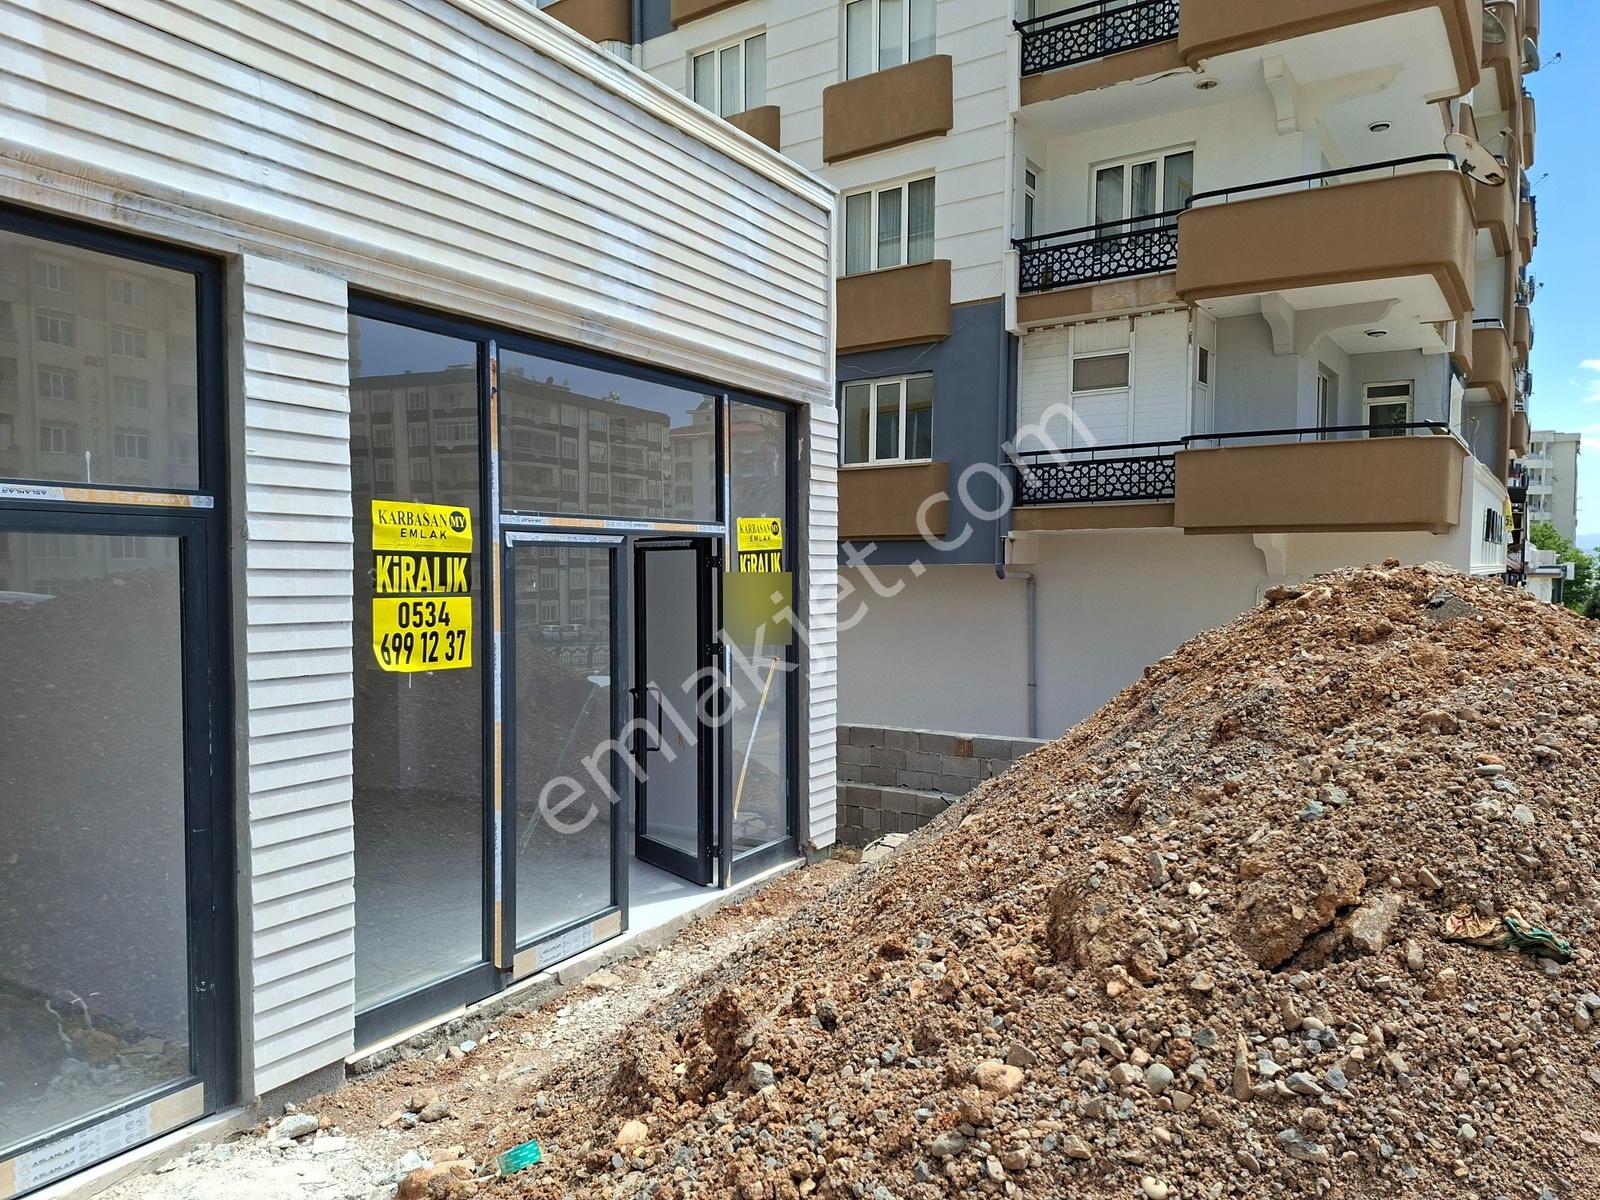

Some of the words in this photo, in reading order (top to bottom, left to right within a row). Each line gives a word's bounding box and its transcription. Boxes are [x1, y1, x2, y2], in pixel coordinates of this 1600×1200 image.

[378, 509, 447, 527] KARBASAN
[450, 515, 465, 528] MY
[400, 528, 447, 540] EMLAK
[398, 601, 451, 629] 0534
[380, 631, 414, 666] 699
[421, 631, 439, 663] 12
[445, 629, 467, 662] 37
